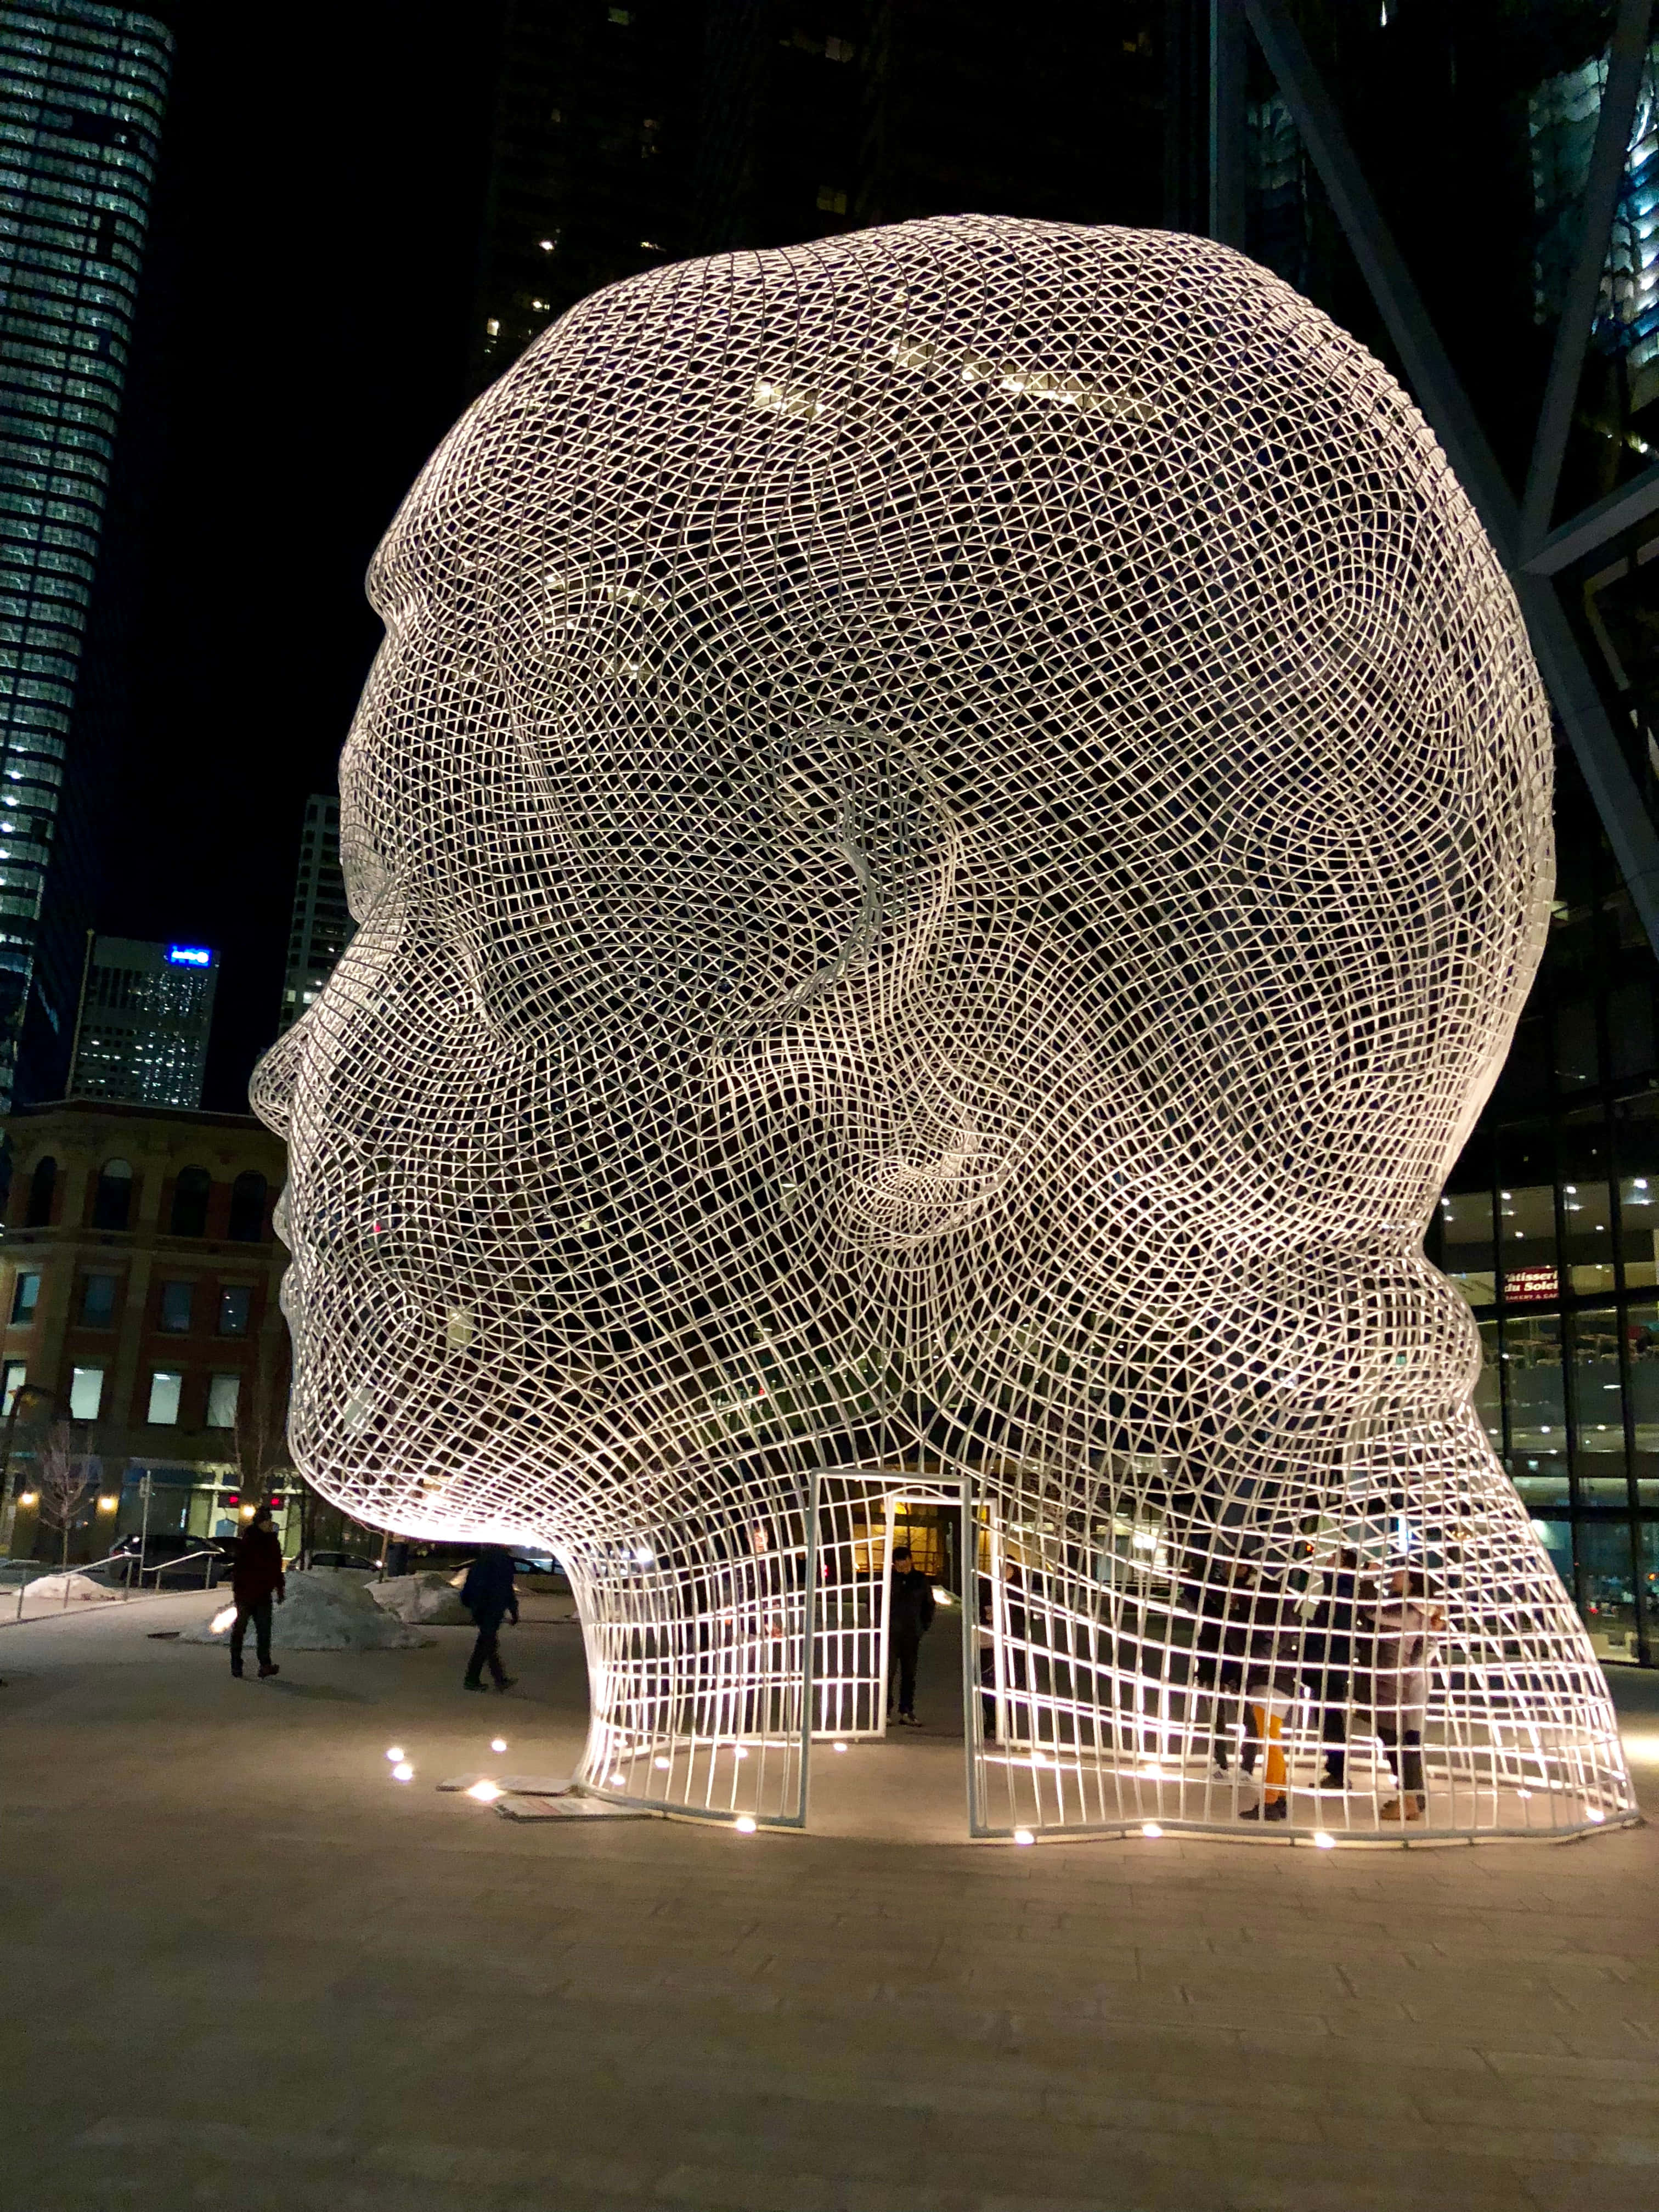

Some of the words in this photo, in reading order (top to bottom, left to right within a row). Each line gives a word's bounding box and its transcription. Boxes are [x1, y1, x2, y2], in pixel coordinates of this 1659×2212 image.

[1505, 1271, 1558, 1282] âtisseri
[1505, 1284, 1520, 1293] du
[1524, 1280, 1559, 1291] Solei
